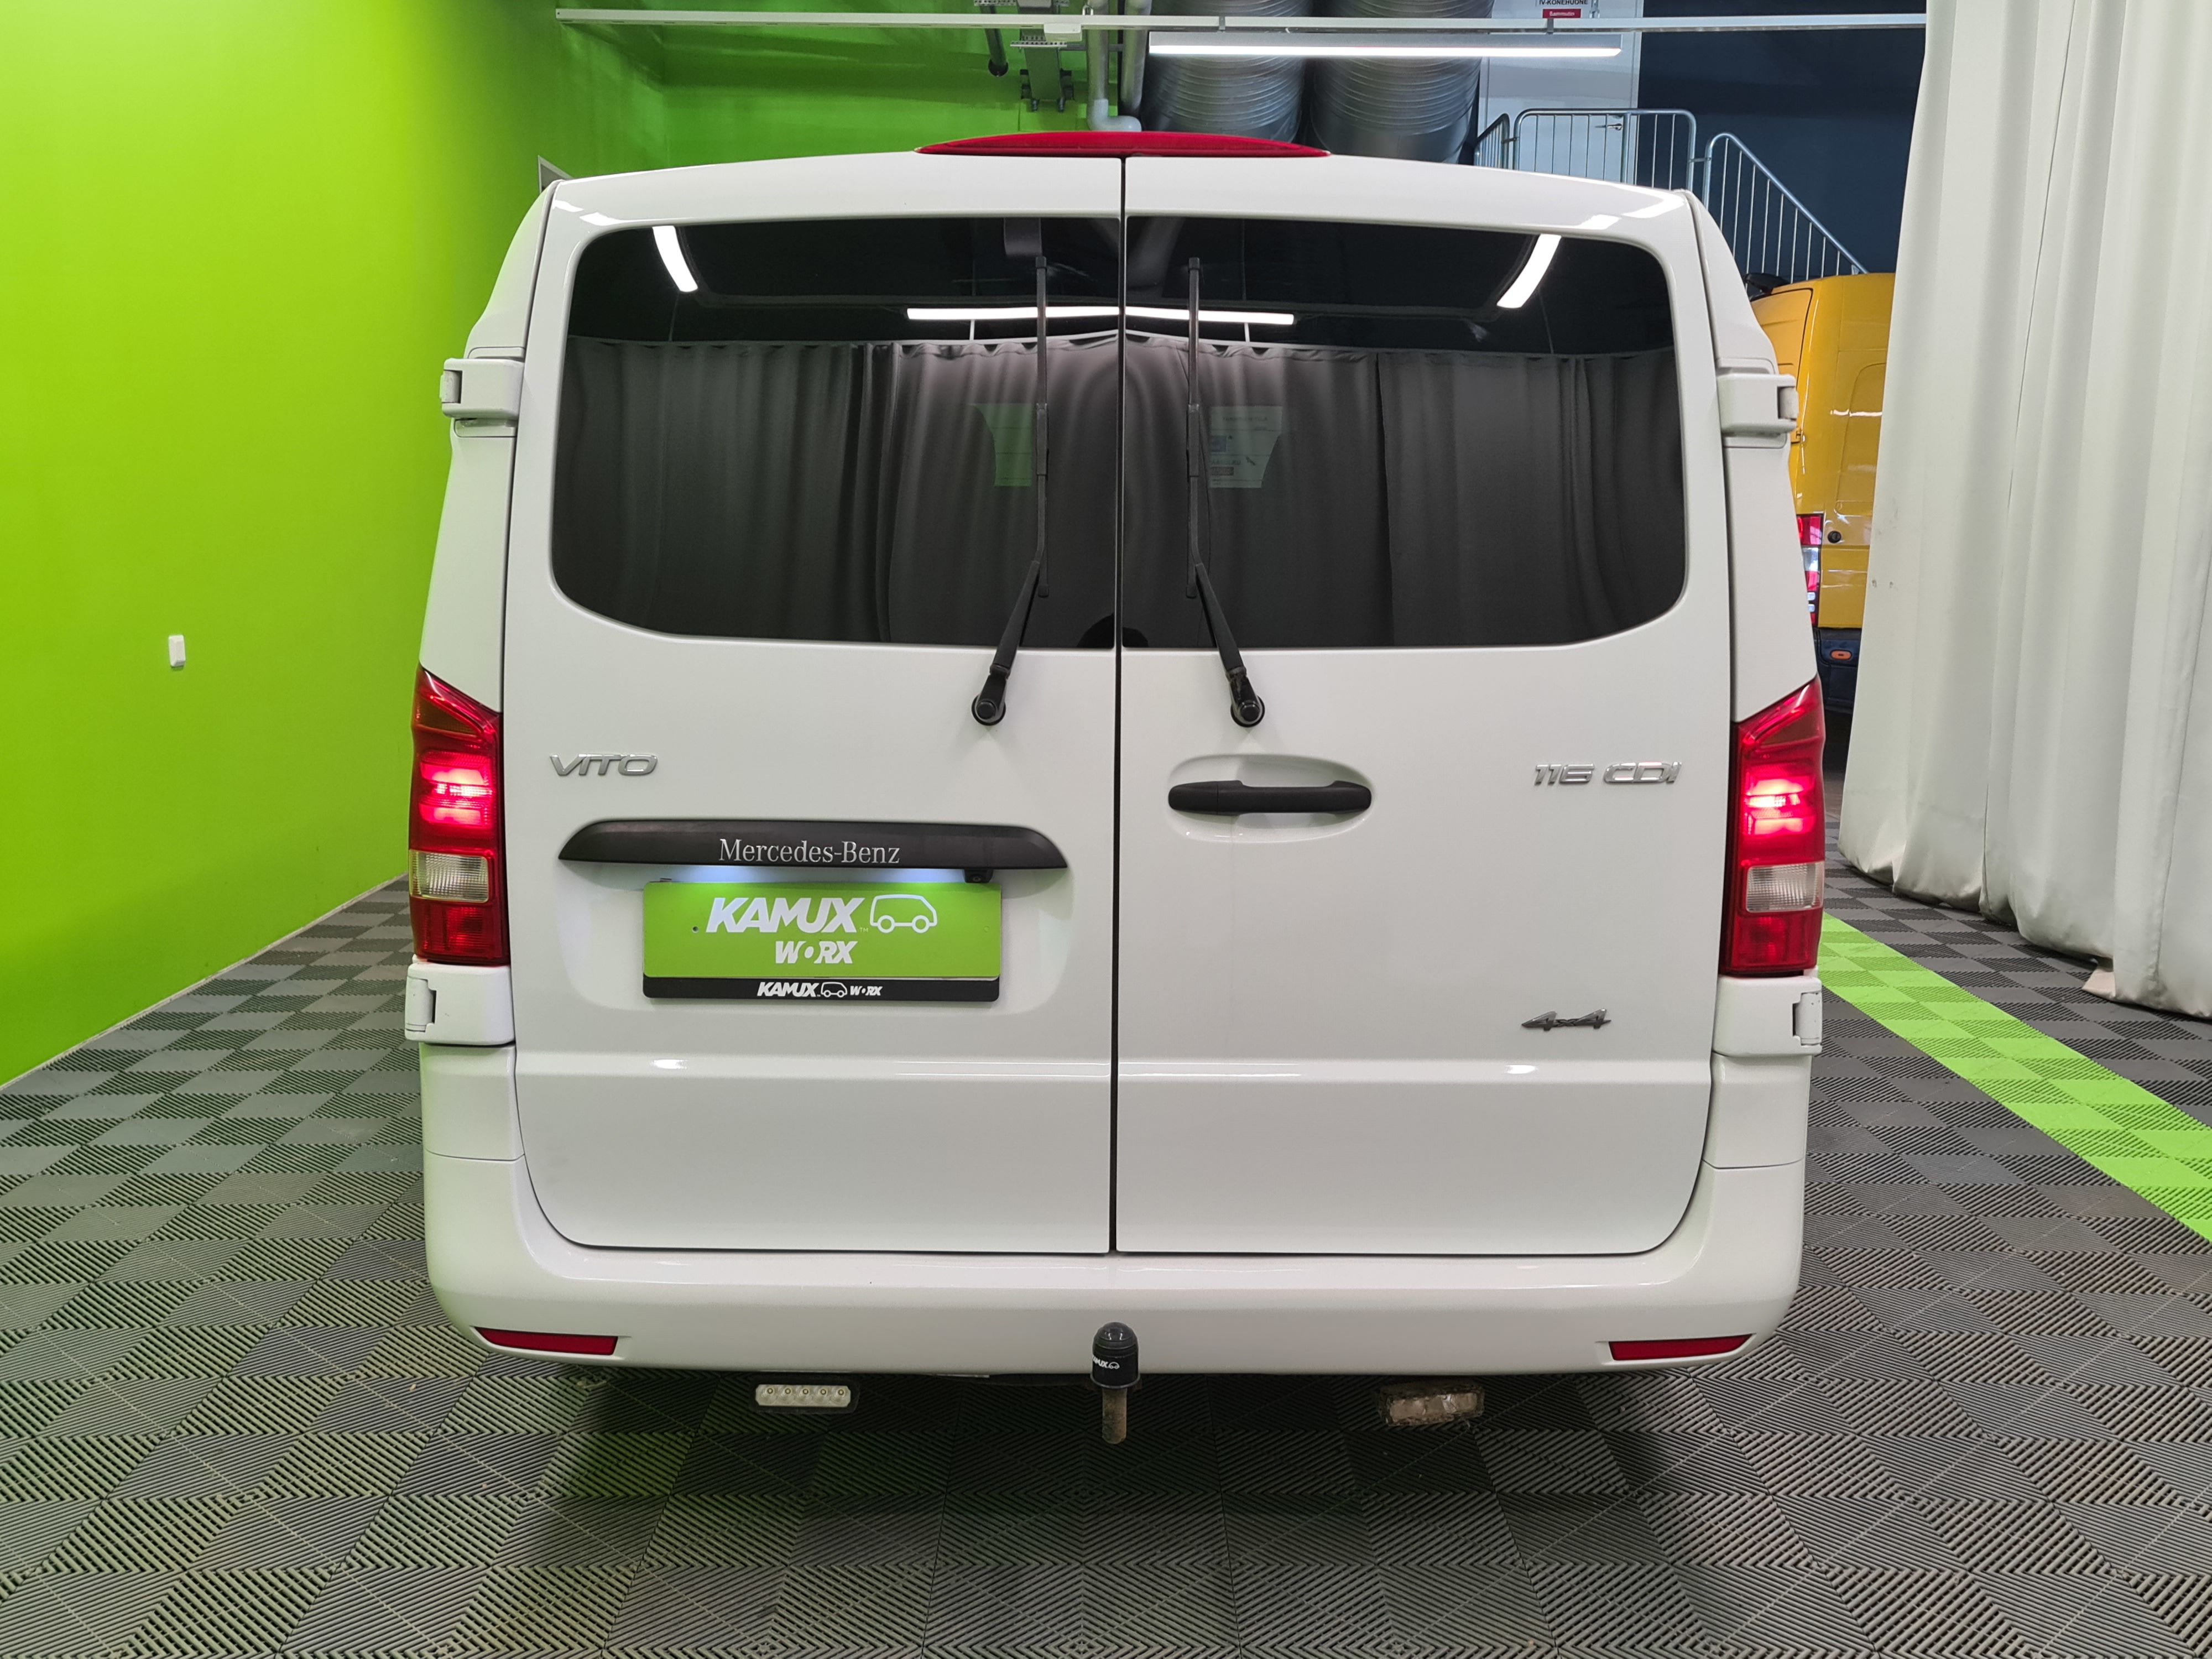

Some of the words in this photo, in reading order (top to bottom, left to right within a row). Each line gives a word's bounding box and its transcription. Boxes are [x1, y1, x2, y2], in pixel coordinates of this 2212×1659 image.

[550, 754, 658, 776] VITO
[1535, 764, 1595, 785] 116
[1604, 761, 1682, 784] CDI
[719, 839, 900, 863] Mercedes-Benz
[706, 897, 865, 933] KAMUX
[757, 982, 820, 997] KAMUX
